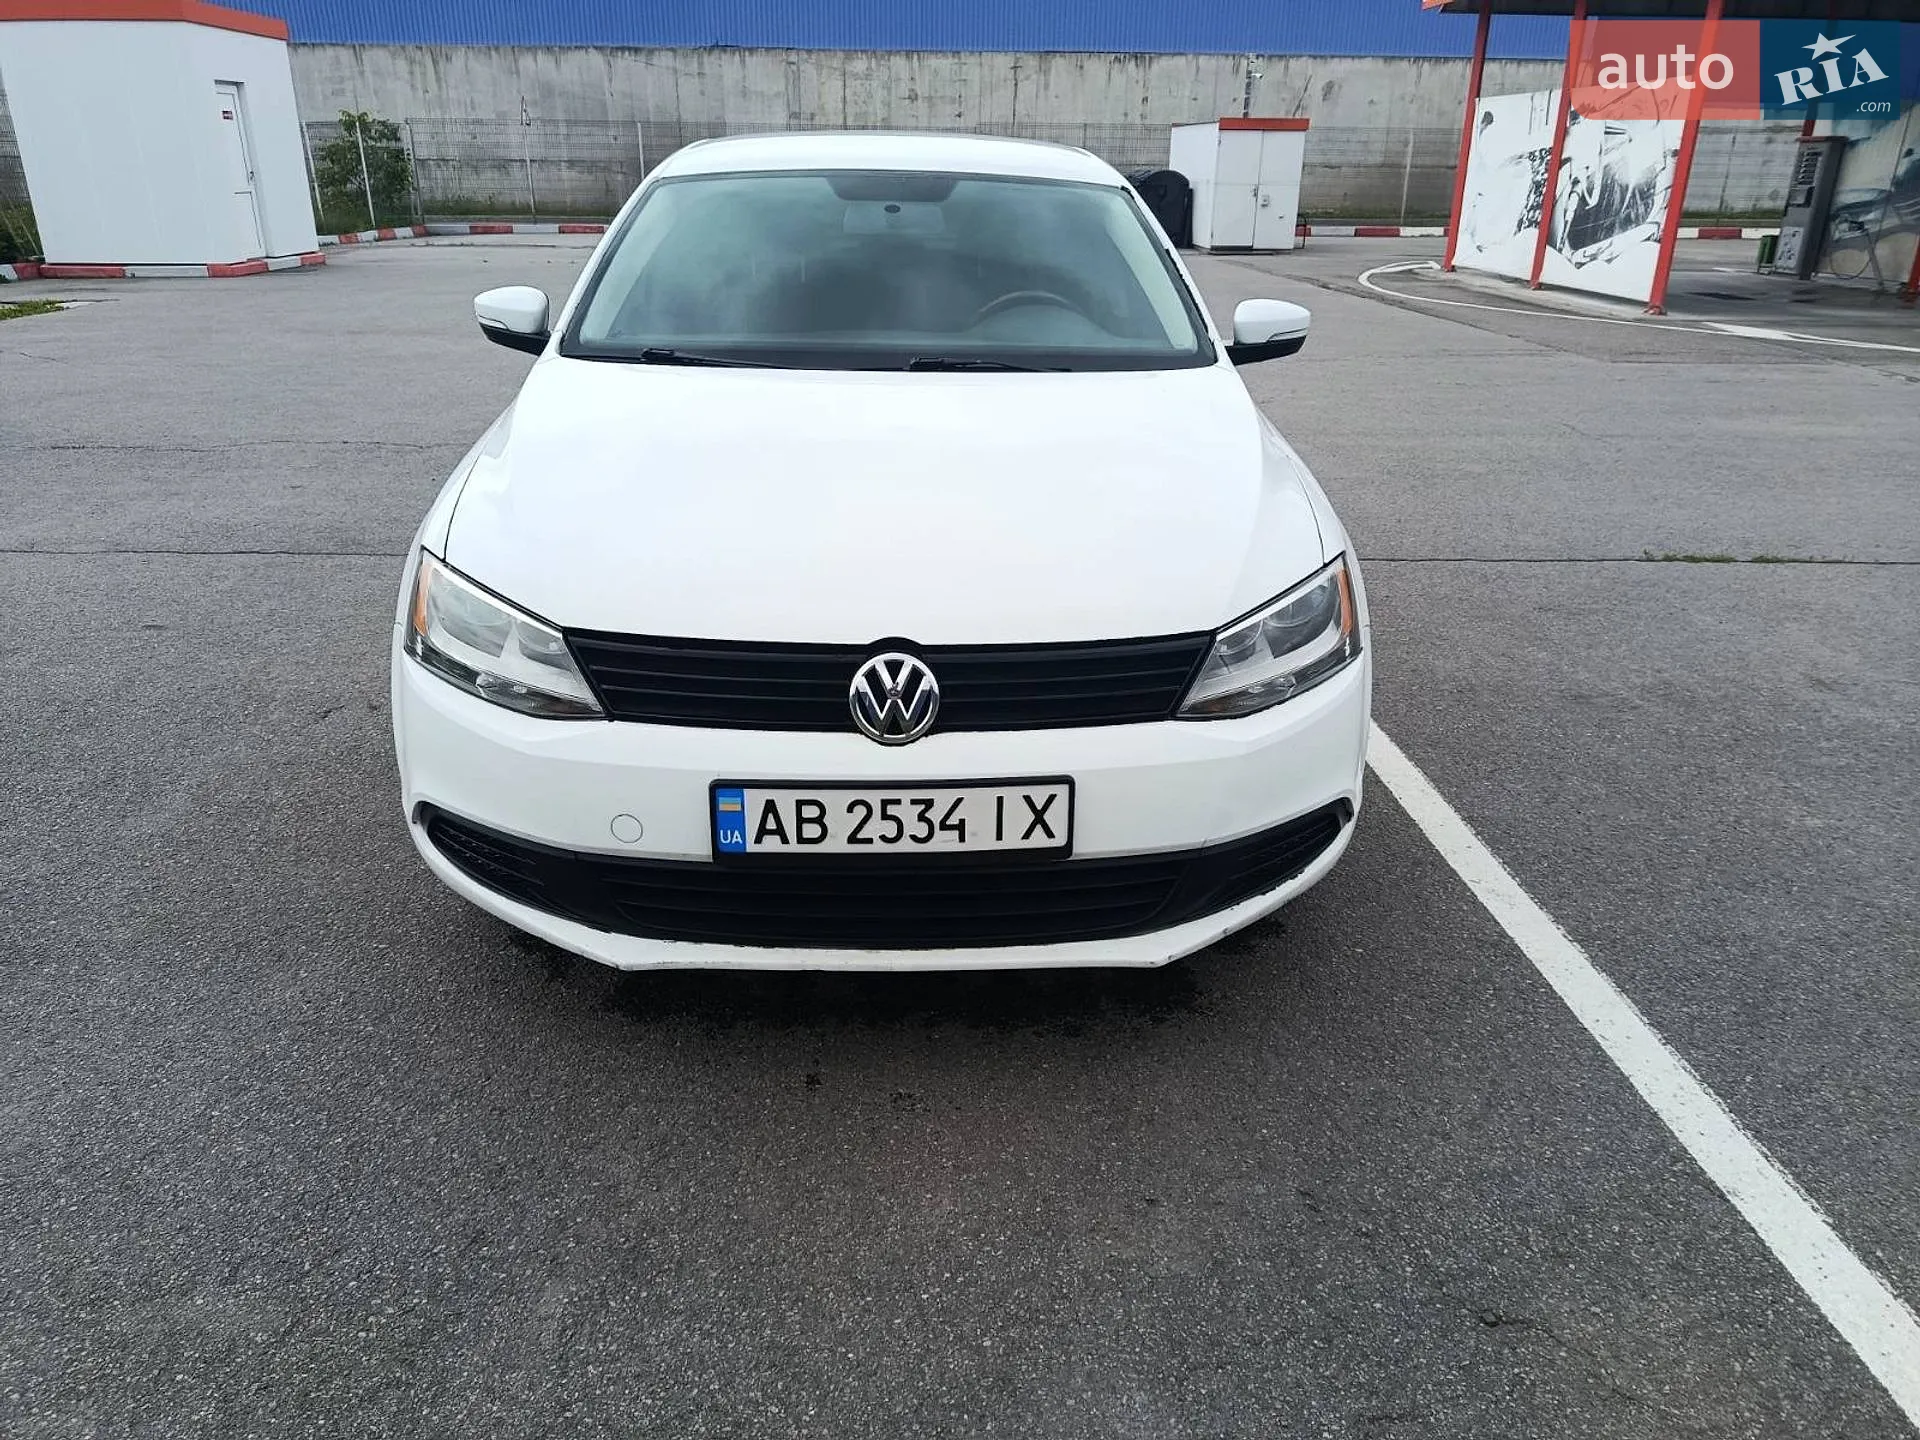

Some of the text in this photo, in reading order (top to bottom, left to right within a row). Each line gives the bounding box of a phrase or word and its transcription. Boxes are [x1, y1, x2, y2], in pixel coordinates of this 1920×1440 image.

[753, 793, 1058, 845] AB 2534 IX
[719, 829, 744, 845] UA
